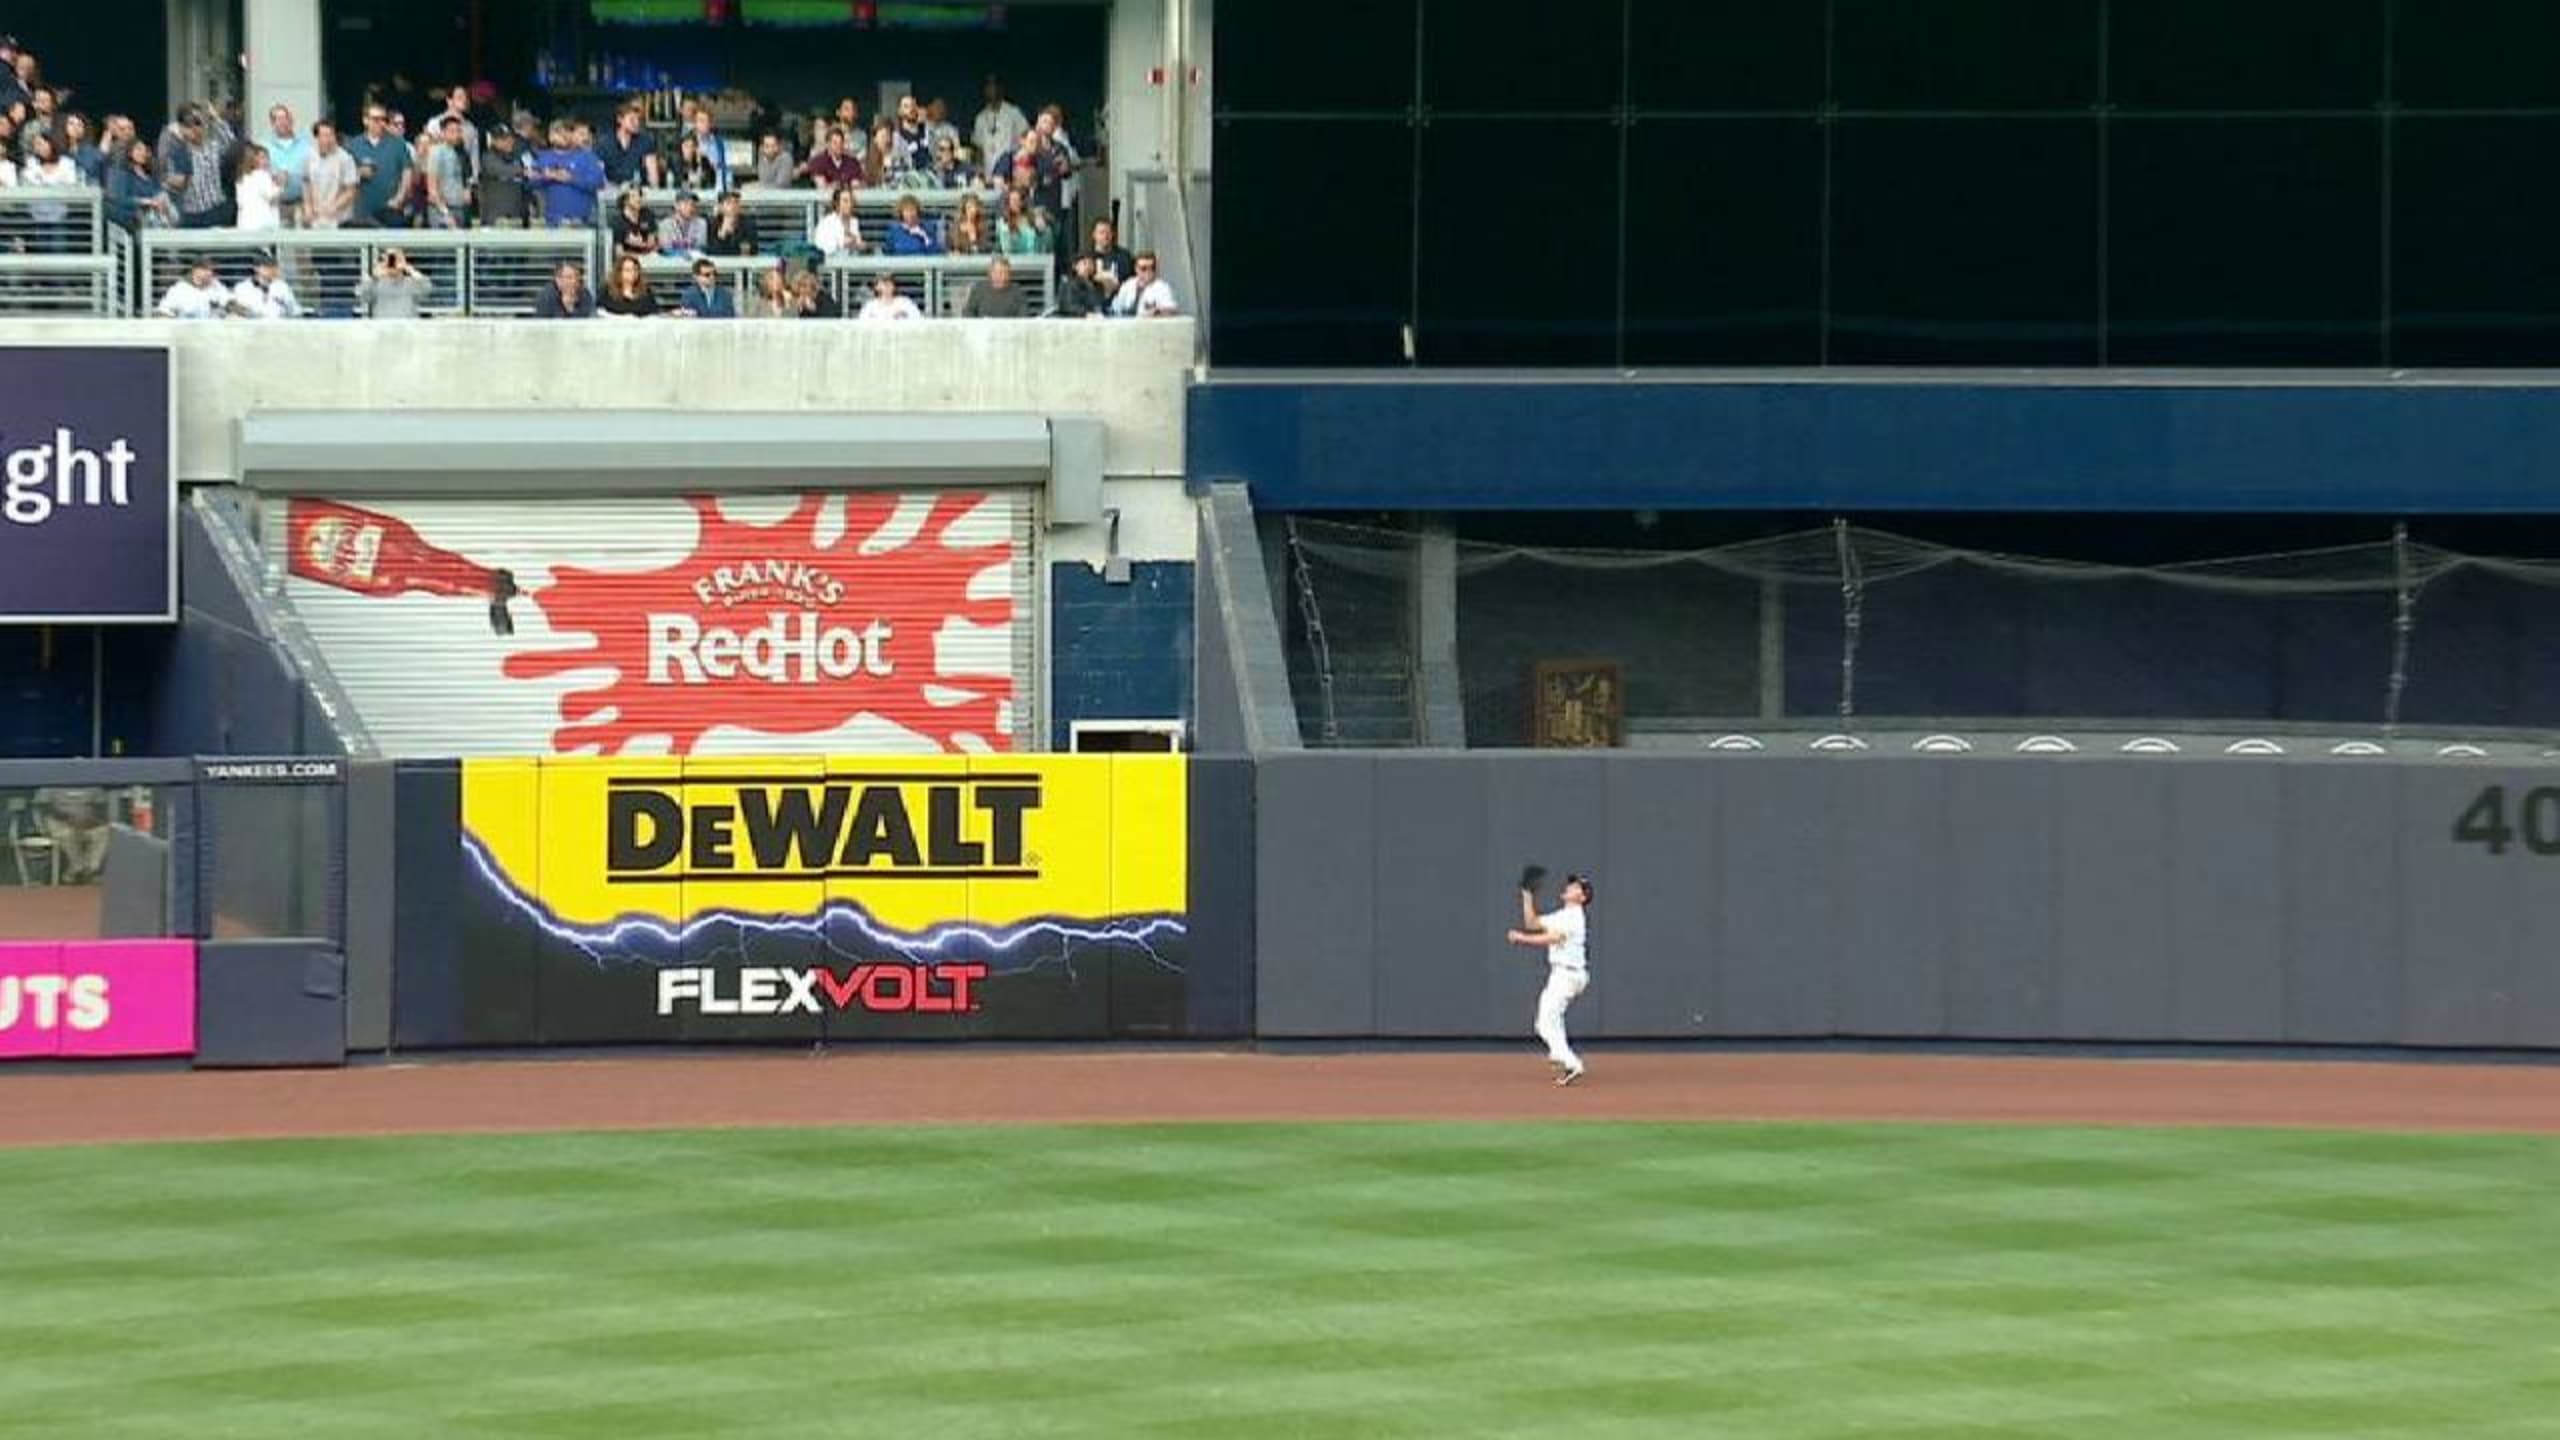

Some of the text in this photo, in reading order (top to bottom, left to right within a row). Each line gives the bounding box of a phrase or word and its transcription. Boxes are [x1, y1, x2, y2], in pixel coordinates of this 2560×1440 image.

[5, 427, 136, 523] ght
[692, 559, 845, 607] FRANK'S
[647, 612, 894, 683] RedHot
[203, 763, 336, 777] YANKEES.COM
[2453, 785, 2560, 855] 40
[657, 965, 986, 1014] FLEXVOLT
